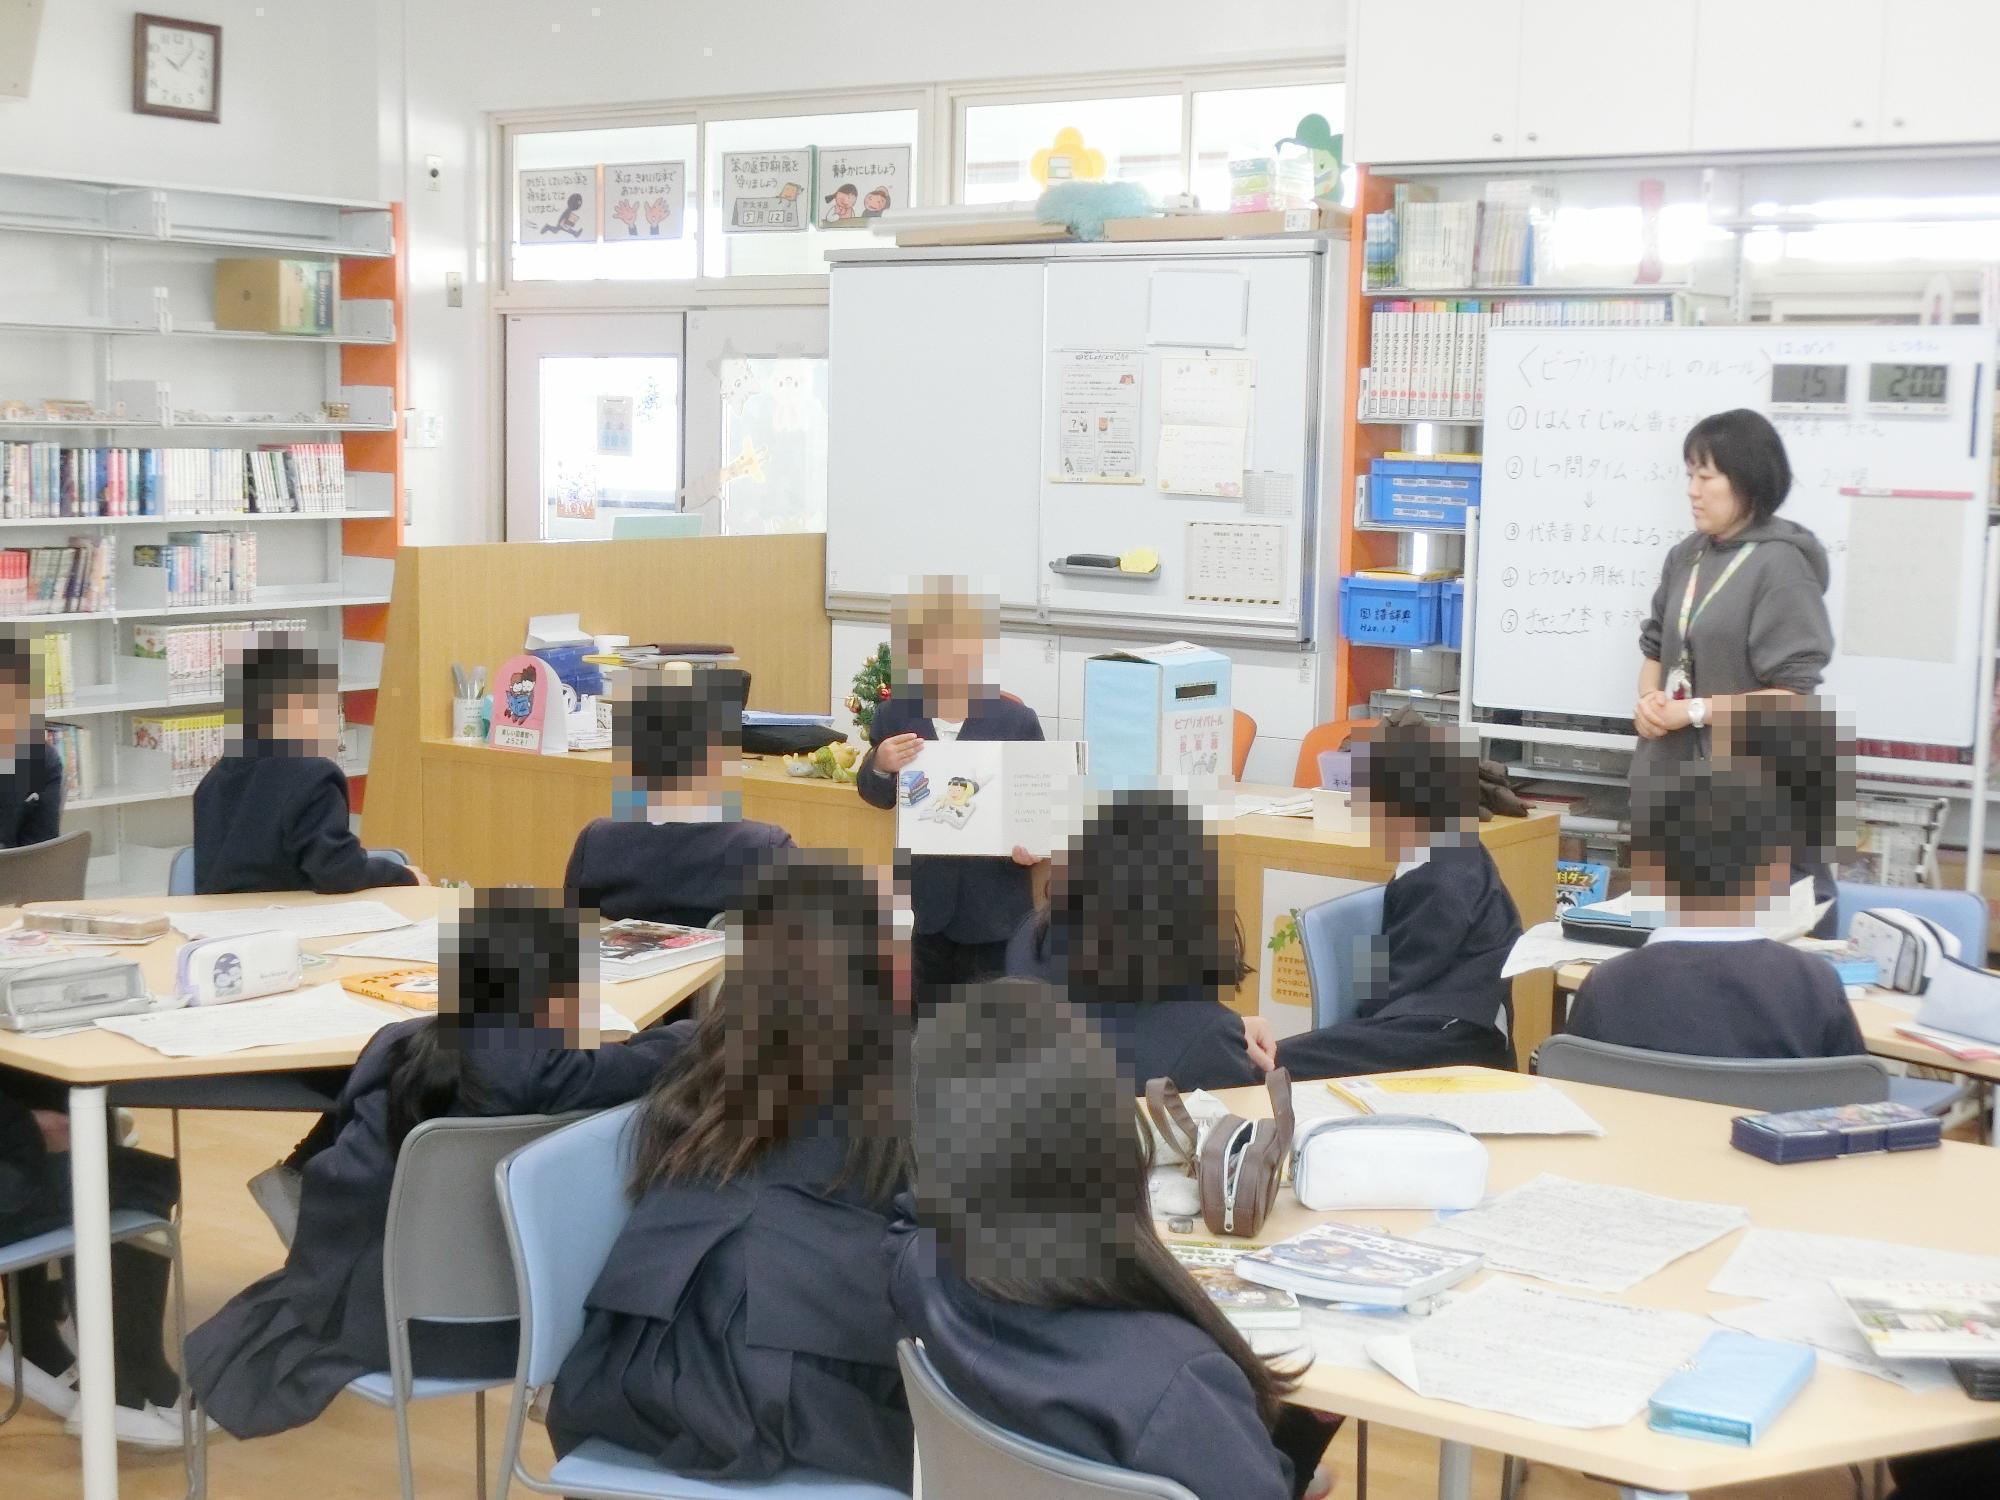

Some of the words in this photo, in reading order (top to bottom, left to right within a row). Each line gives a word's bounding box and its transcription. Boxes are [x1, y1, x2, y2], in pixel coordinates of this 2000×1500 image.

[832, 163, 896, 178] 静かにしましょう
[735, 175, 778, 189] 守りましょう
[1174, 714, 1224, 730] ビブリオバトル
[501, 728, 534, 739] 楽しい図書館へ
[1555, 870, 1601, 887] 科ダマン
